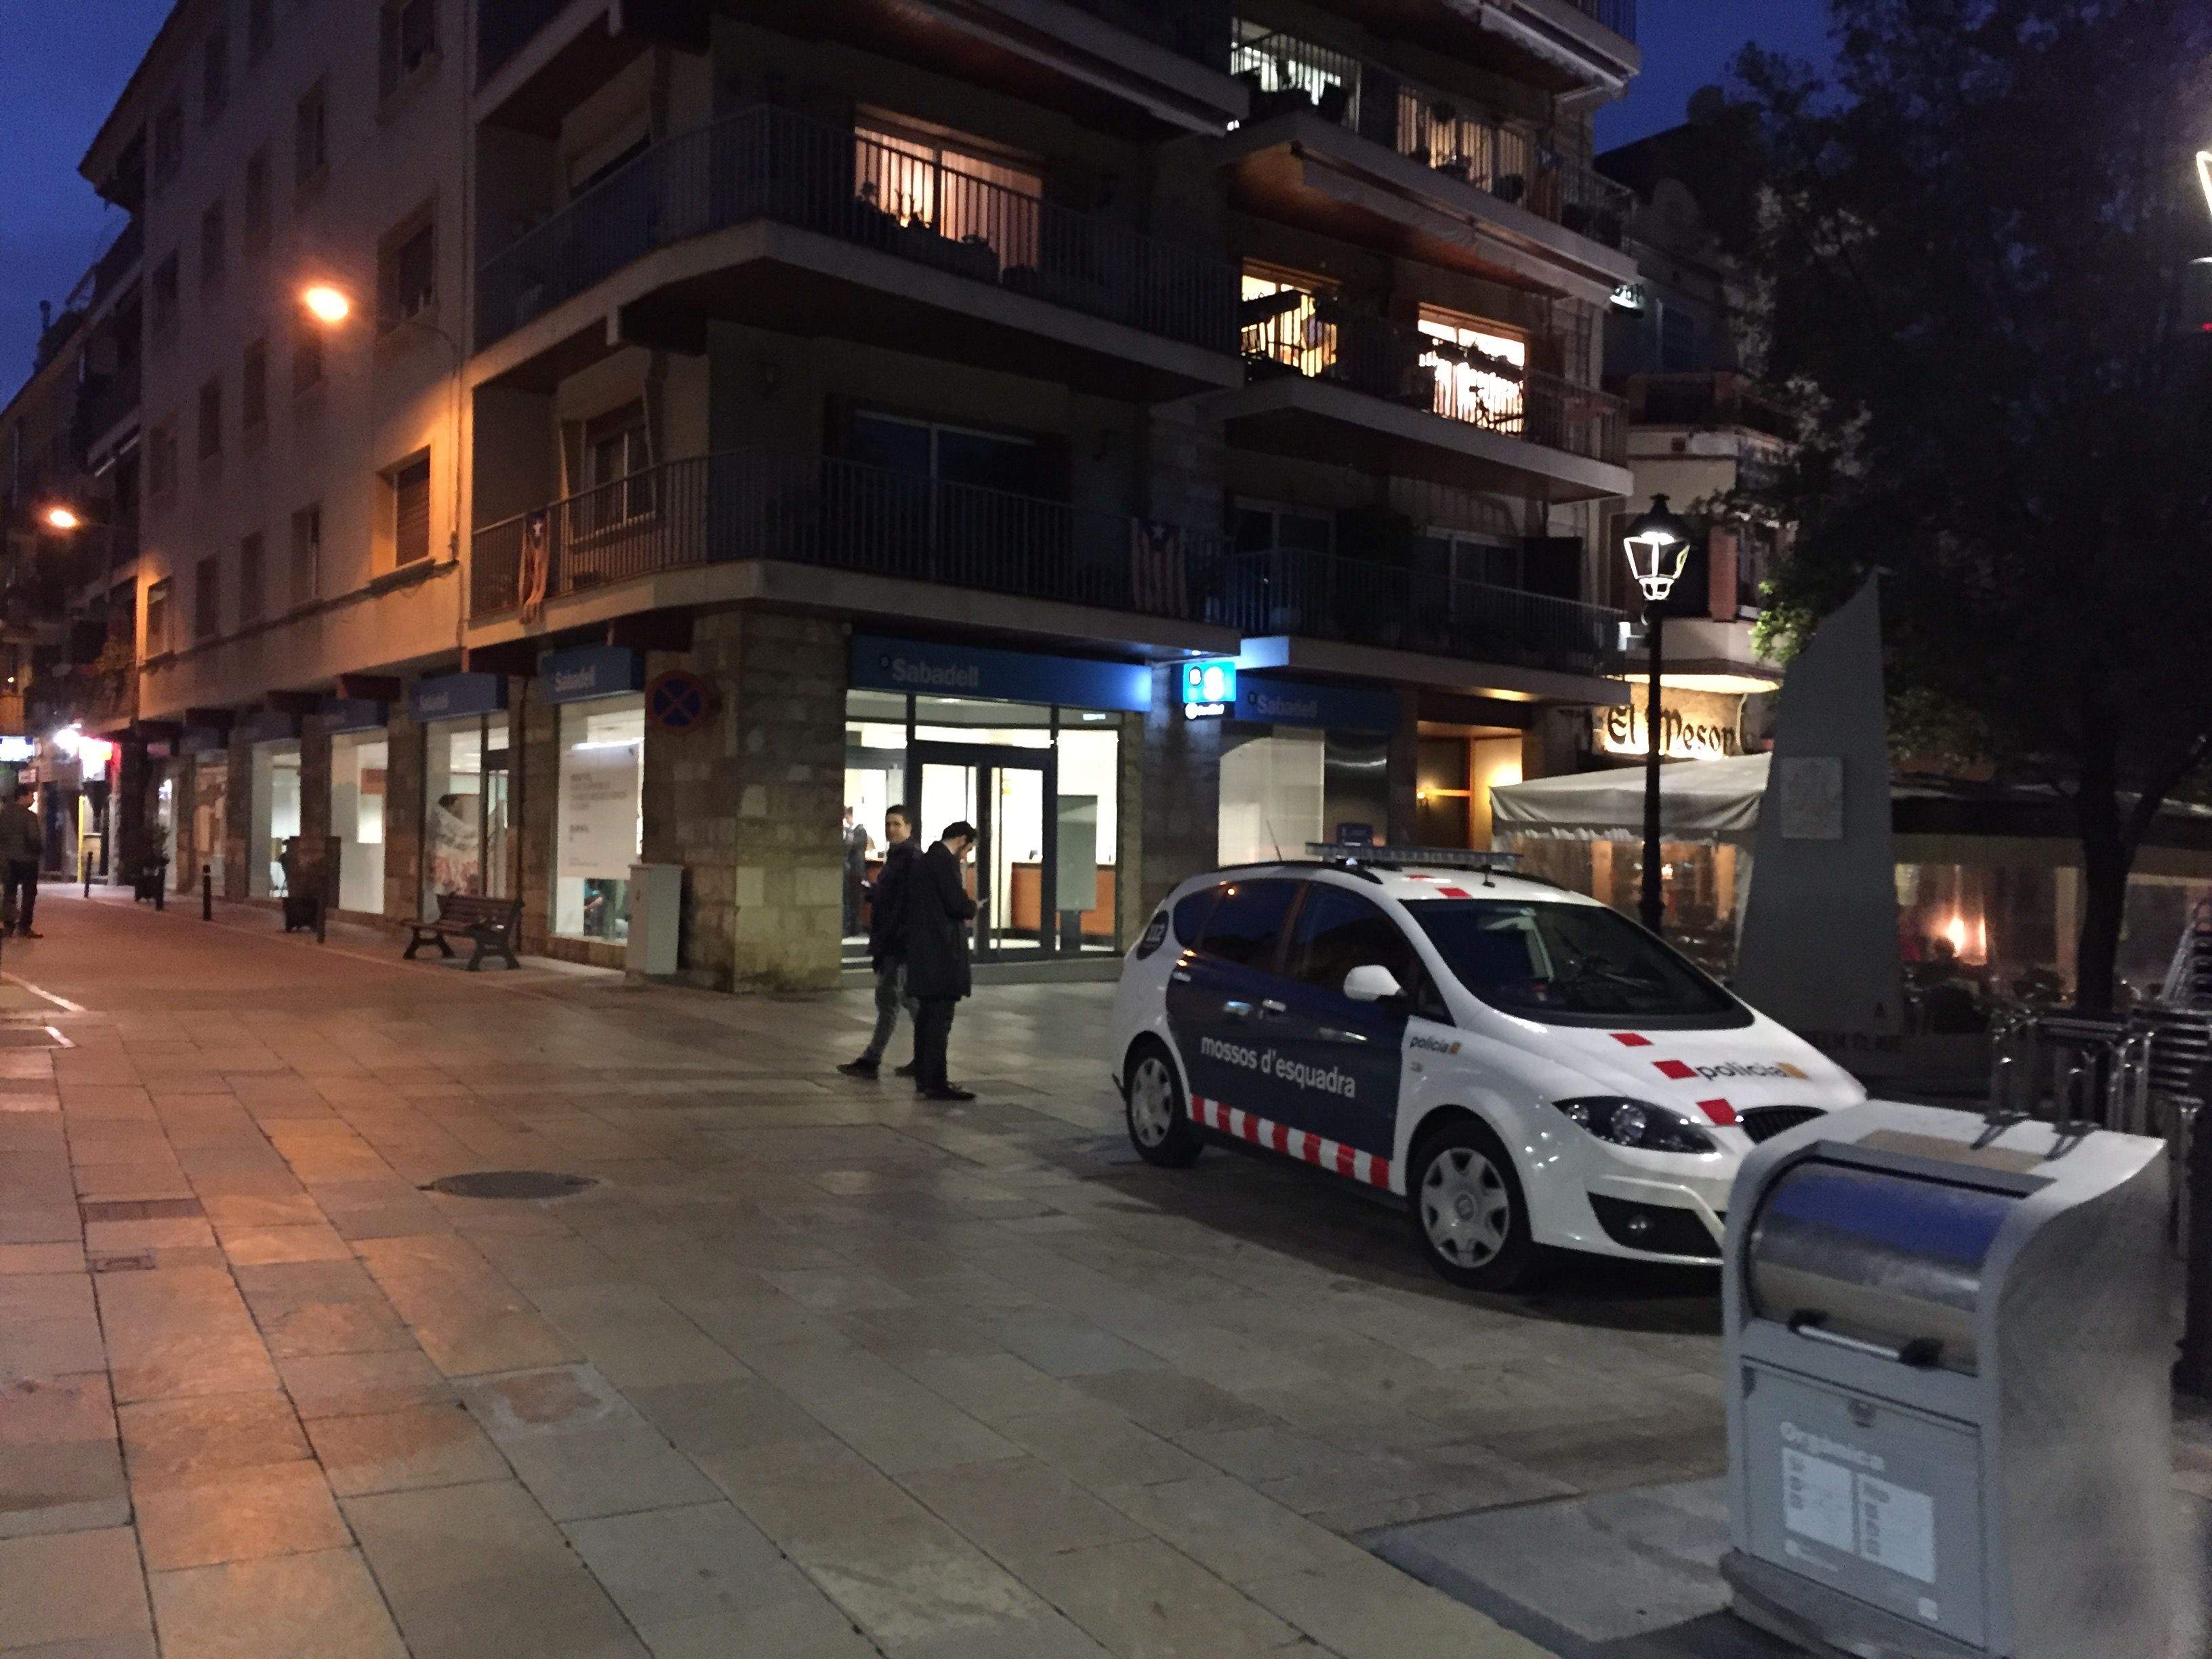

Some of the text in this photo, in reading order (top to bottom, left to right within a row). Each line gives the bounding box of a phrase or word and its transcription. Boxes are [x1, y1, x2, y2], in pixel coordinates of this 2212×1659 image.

[893, 657, 979, 687] Sabadell
[1607, 704, 1635, 745] El
[1202, 1036, 1355, 1099] mossos d'esquadra
